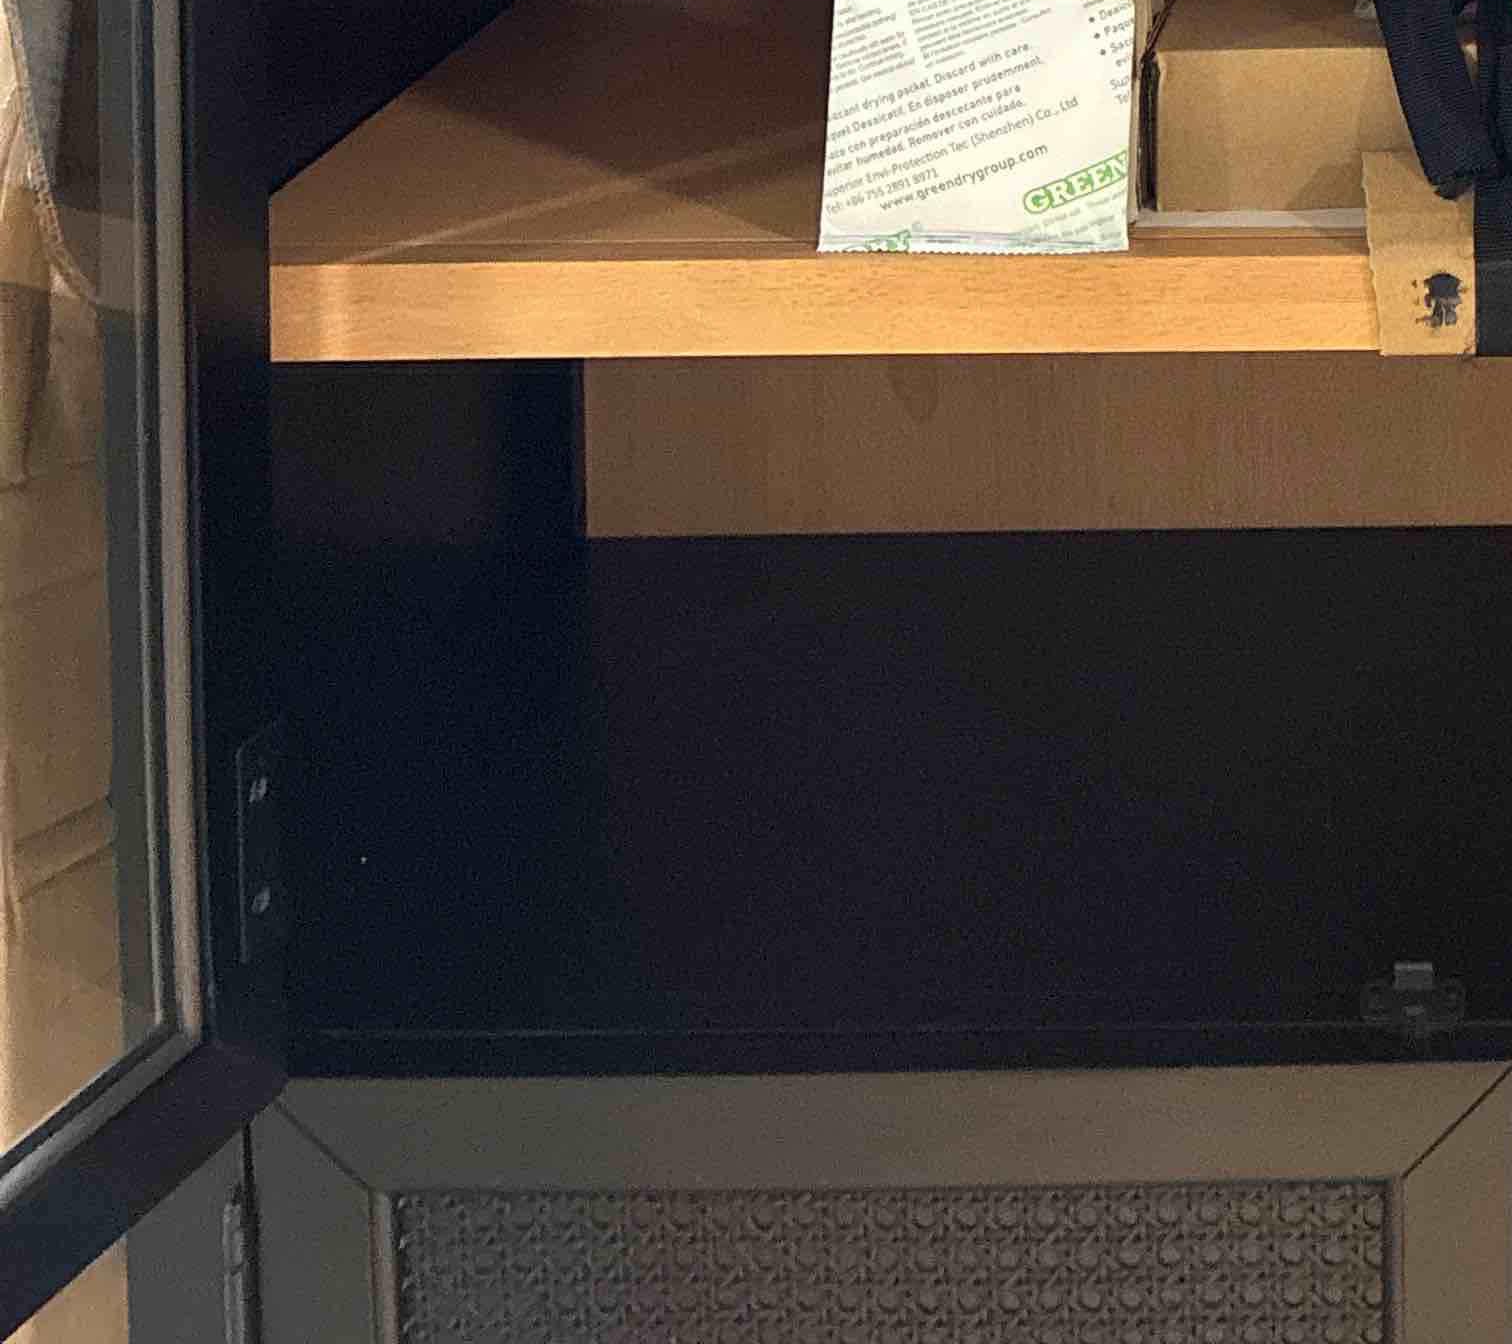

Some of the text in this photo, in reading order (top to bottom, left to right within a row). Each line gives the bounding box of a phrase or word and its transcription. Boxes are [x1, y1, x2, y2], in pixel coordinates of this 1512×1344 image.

[862, 92, 896, 111] drying
[934, 61, 976, 84] Discard
[979, 51, 1002, 67] with
[848, 140, 866, 153] con
[995, 84, 1022, 101] para
[907, 123, 956, 146] Remover
[958, 115, 979, 129] con
[880, 143, 1049, 211] www.greendrygroup.com
